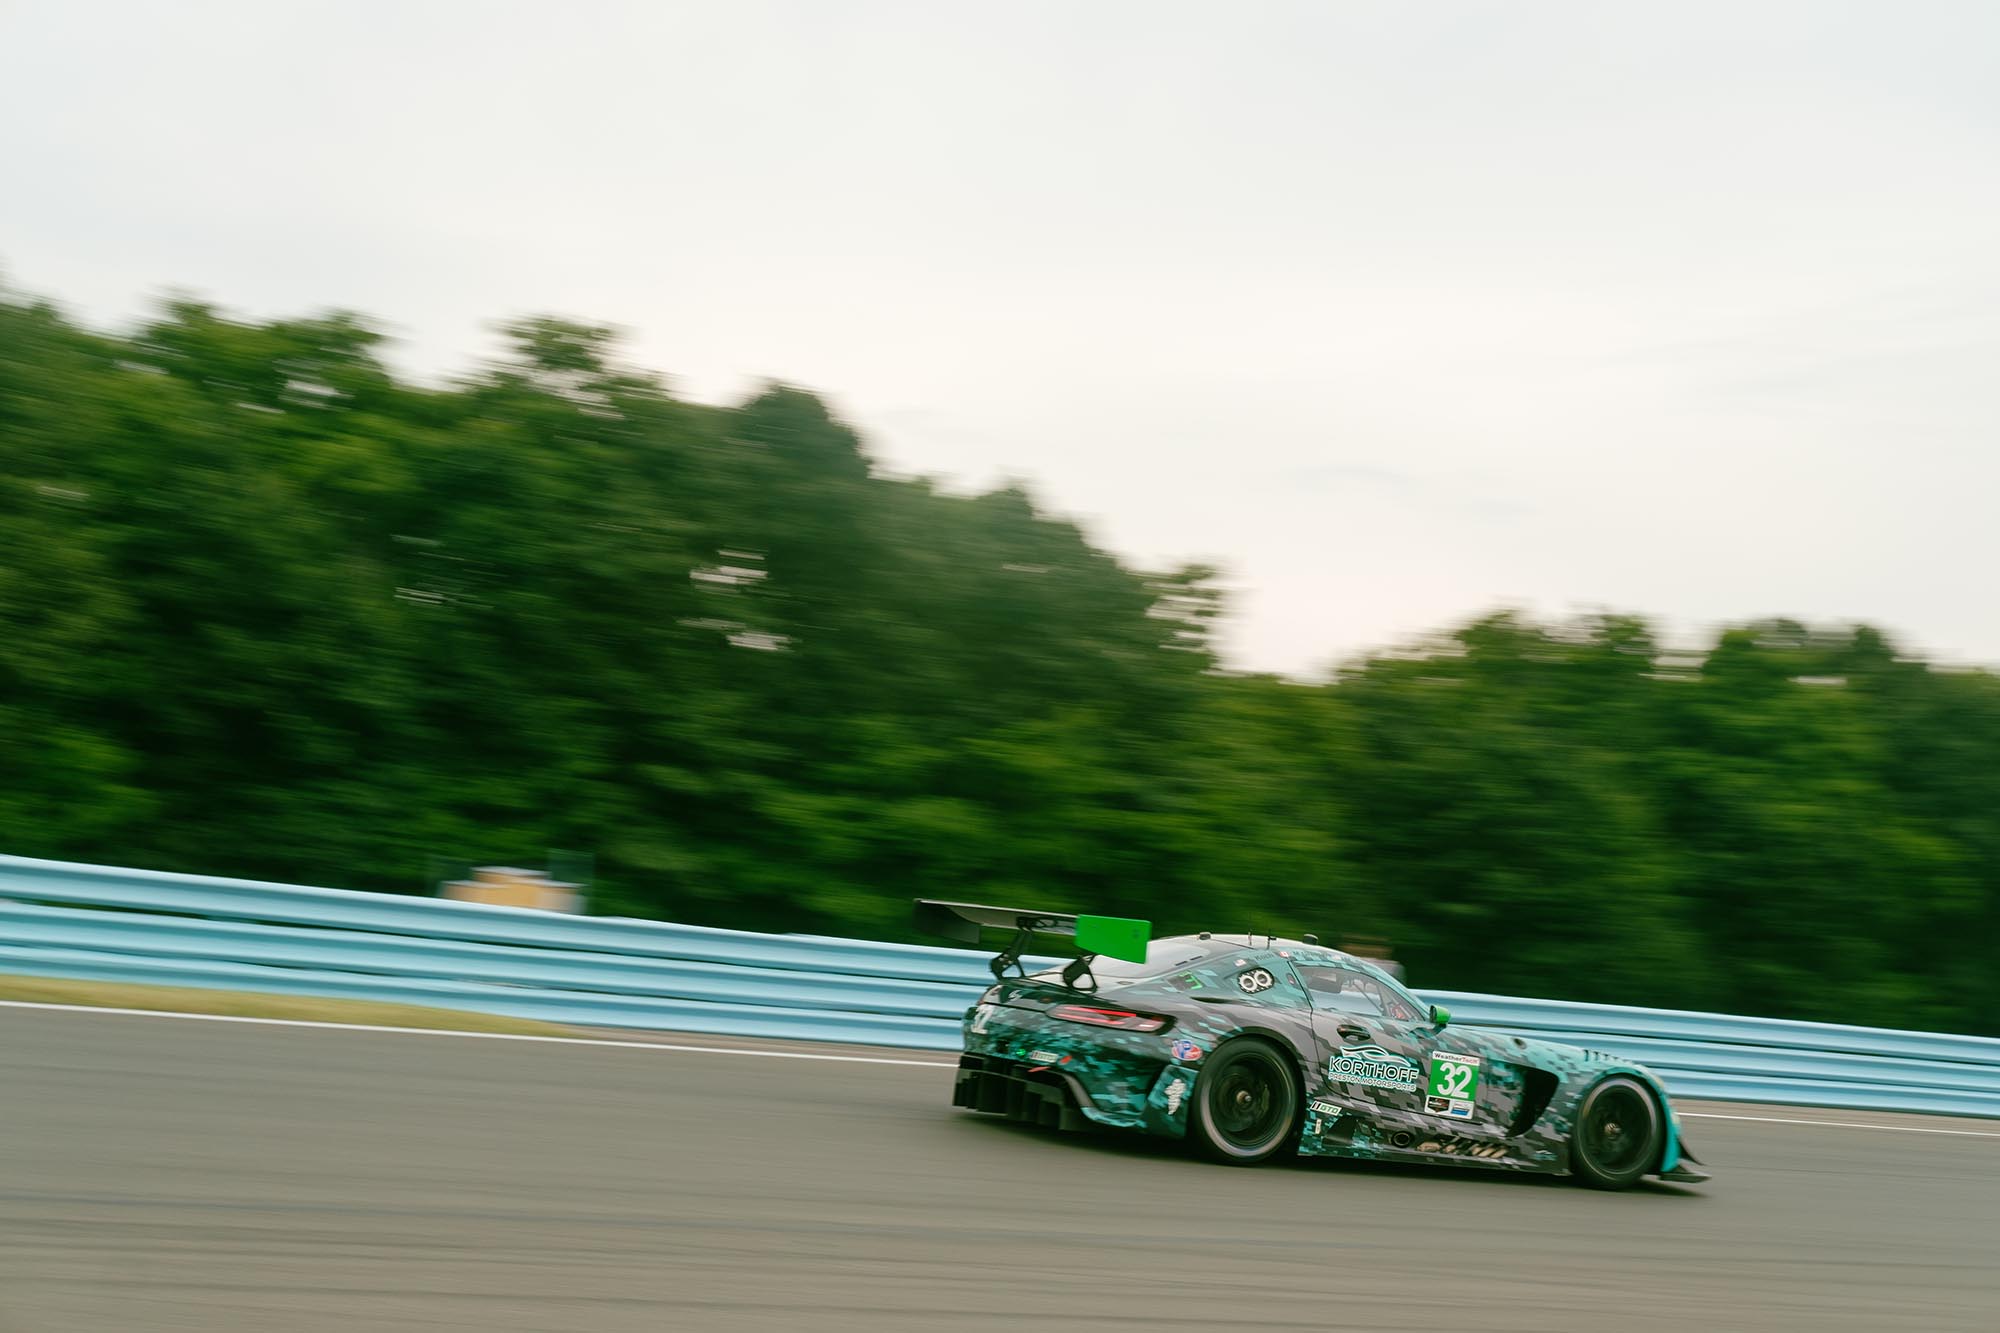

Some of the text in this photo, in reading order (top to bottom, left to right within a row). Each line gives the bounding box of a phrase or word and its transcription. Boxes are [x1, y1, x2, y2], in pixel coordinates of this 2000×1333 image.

[1433, 1052, 1478, 1064] WeatherTech
[1330, 1056, 1419, 1082] KORTHOFF
[1328, 1072, 1417, 1092] PRESTON MOTORSPORTS
[1437, 1062, 1472, 1099] 32
[1320, 1104, 1339, 1114] GTD
